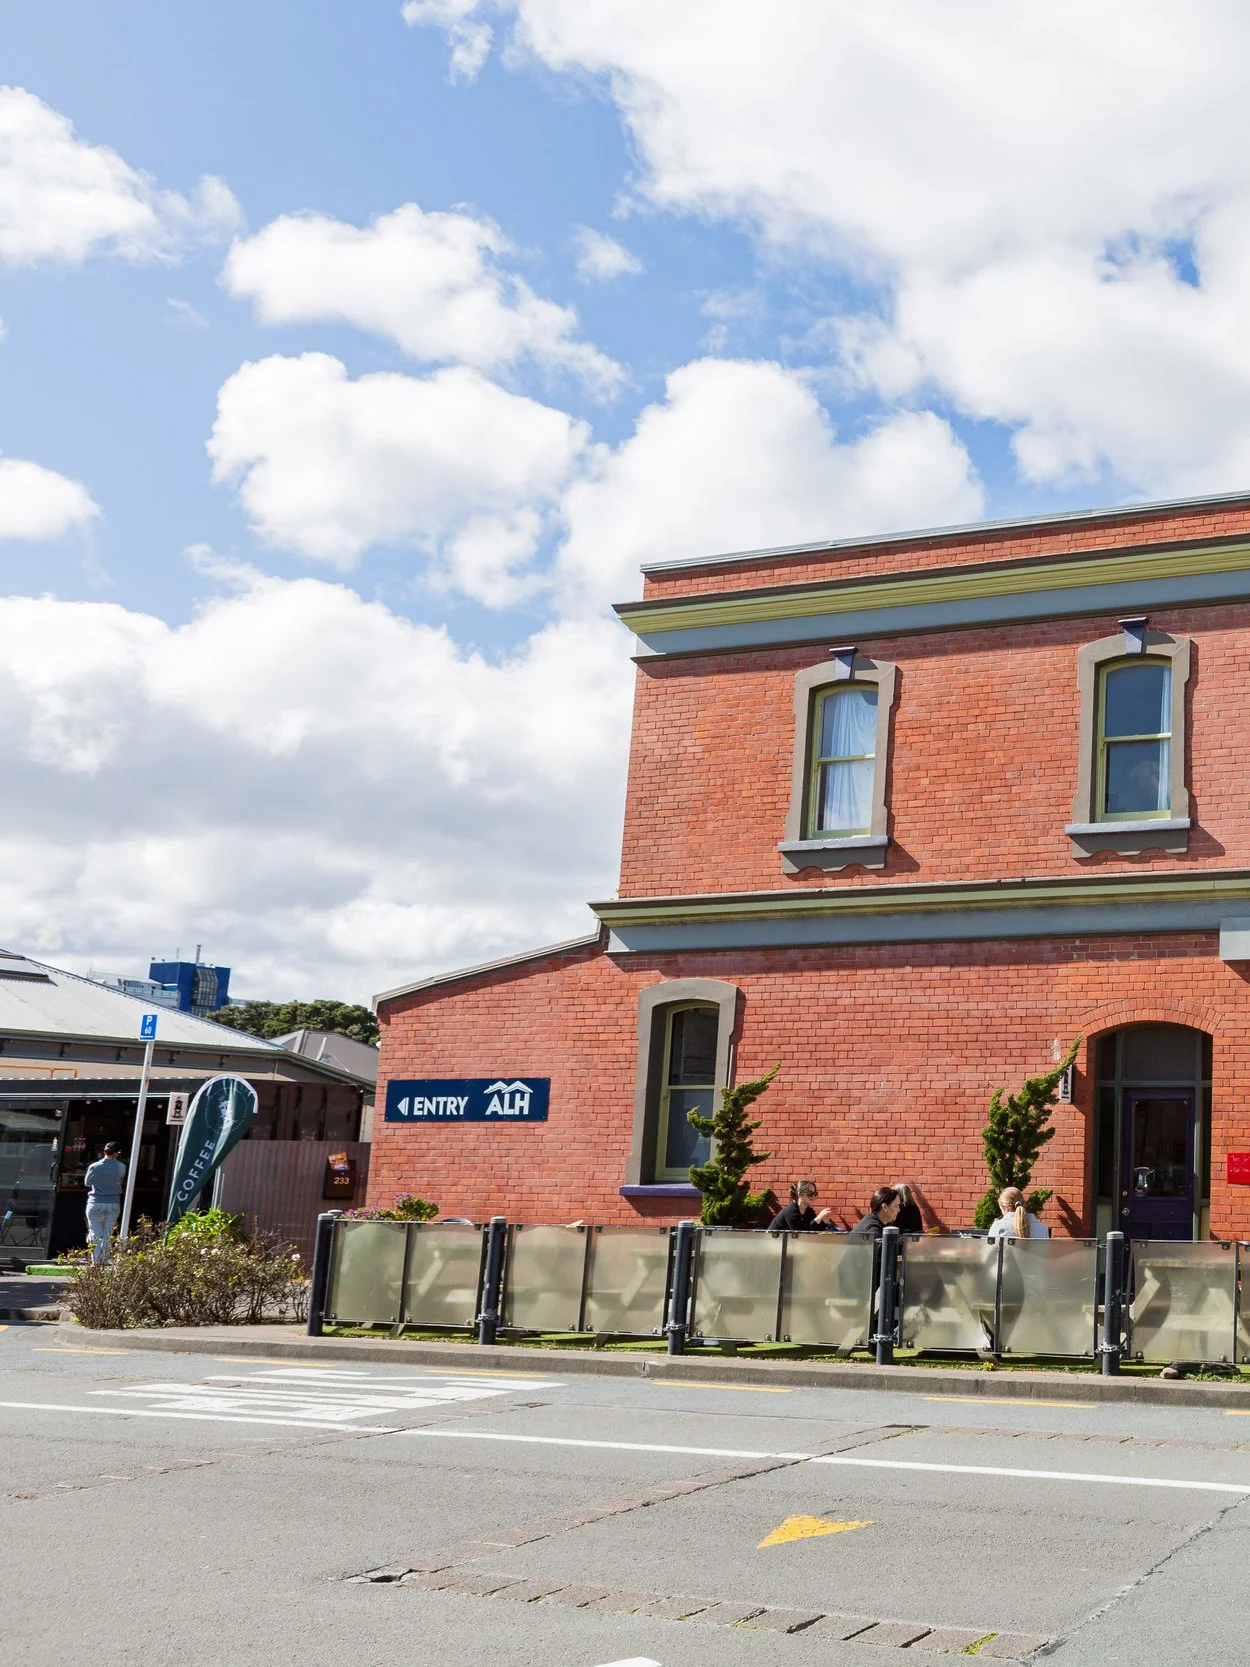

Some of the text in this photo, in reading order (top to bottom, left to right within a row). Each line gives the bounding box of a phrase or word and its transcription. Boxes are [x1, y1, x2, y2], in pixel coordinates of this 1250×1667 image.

[146, 1015, 153, 1026] P
[412, 1096, 469, 1116] ENTRY
[485, 1093, 531, 1115] ALH
[176, 1139, 216, 1202] COFFEE
[333, 1176, 350, 1185] 233
